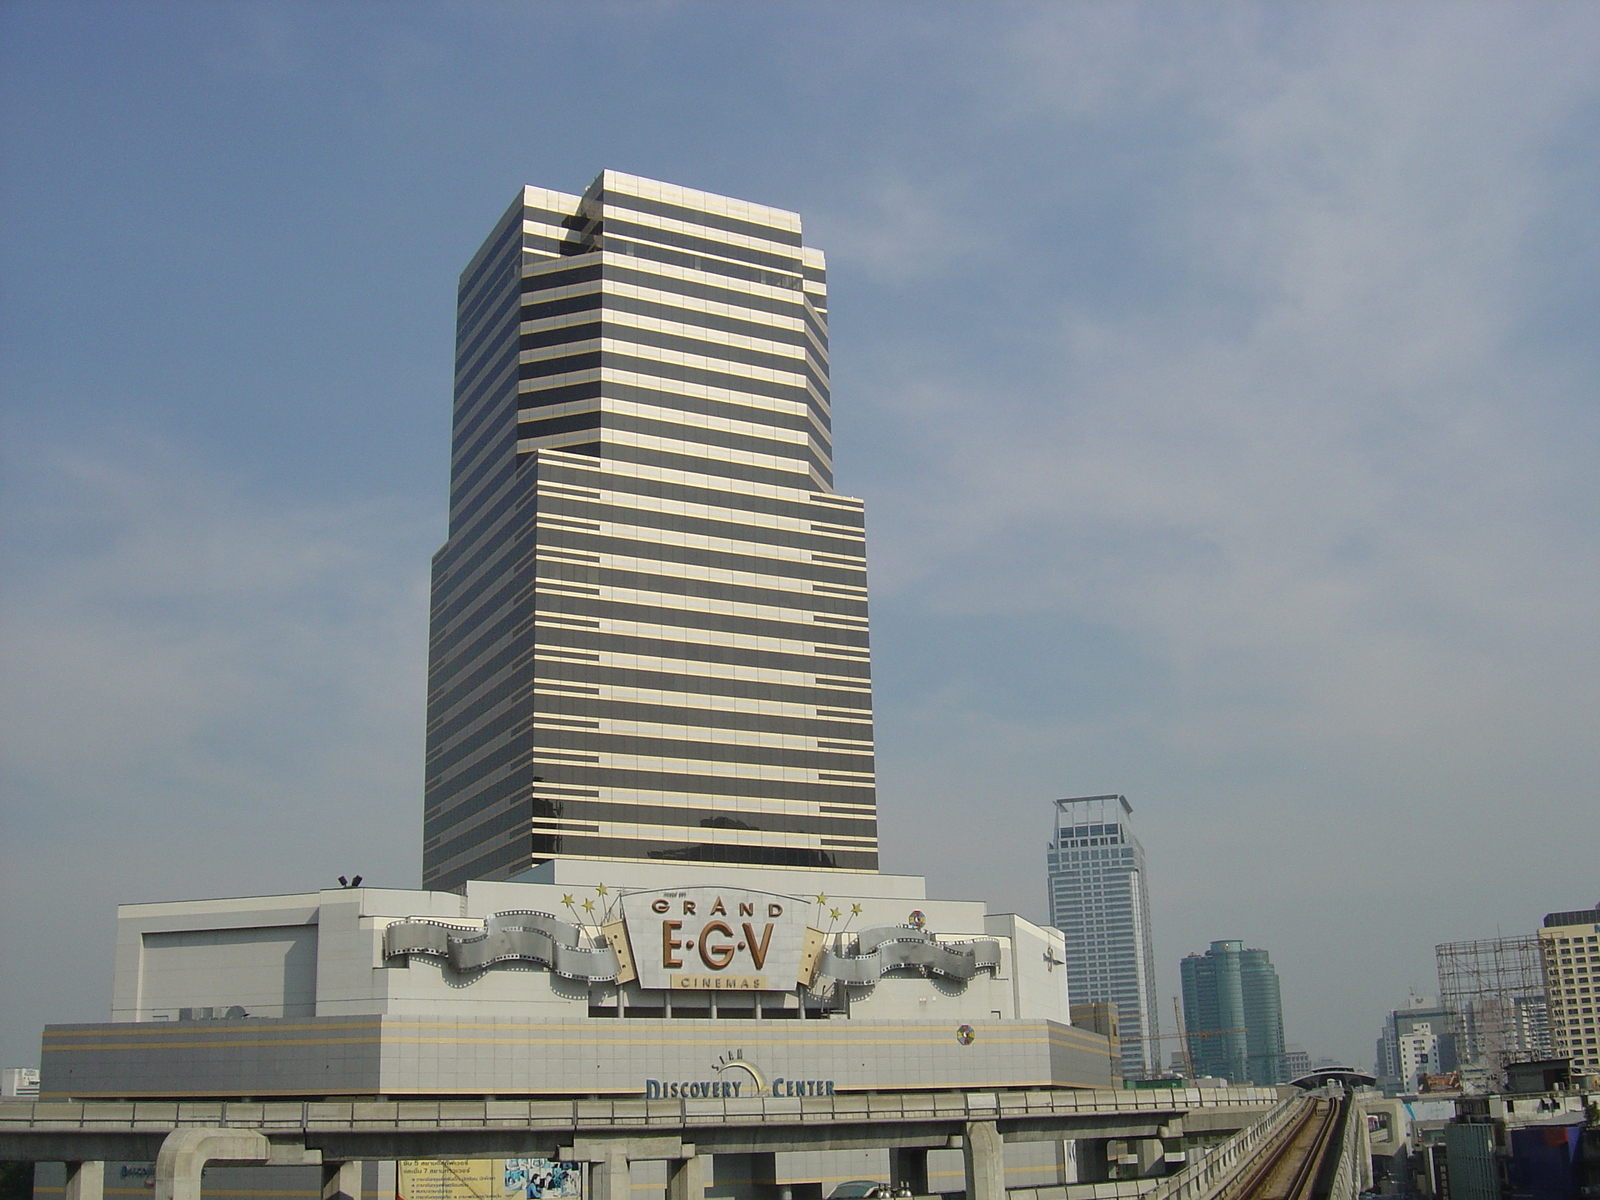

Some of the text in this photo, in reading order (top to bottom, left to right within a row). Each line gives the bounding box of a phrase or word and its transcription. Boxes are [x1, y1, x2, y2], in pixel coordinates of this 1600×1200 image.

[651, 896, 784, 918] GRAND
[680, 977, 761, 989] CINEMAS
[646, 1077, 835, 1099] DISCOVERY CENTER
